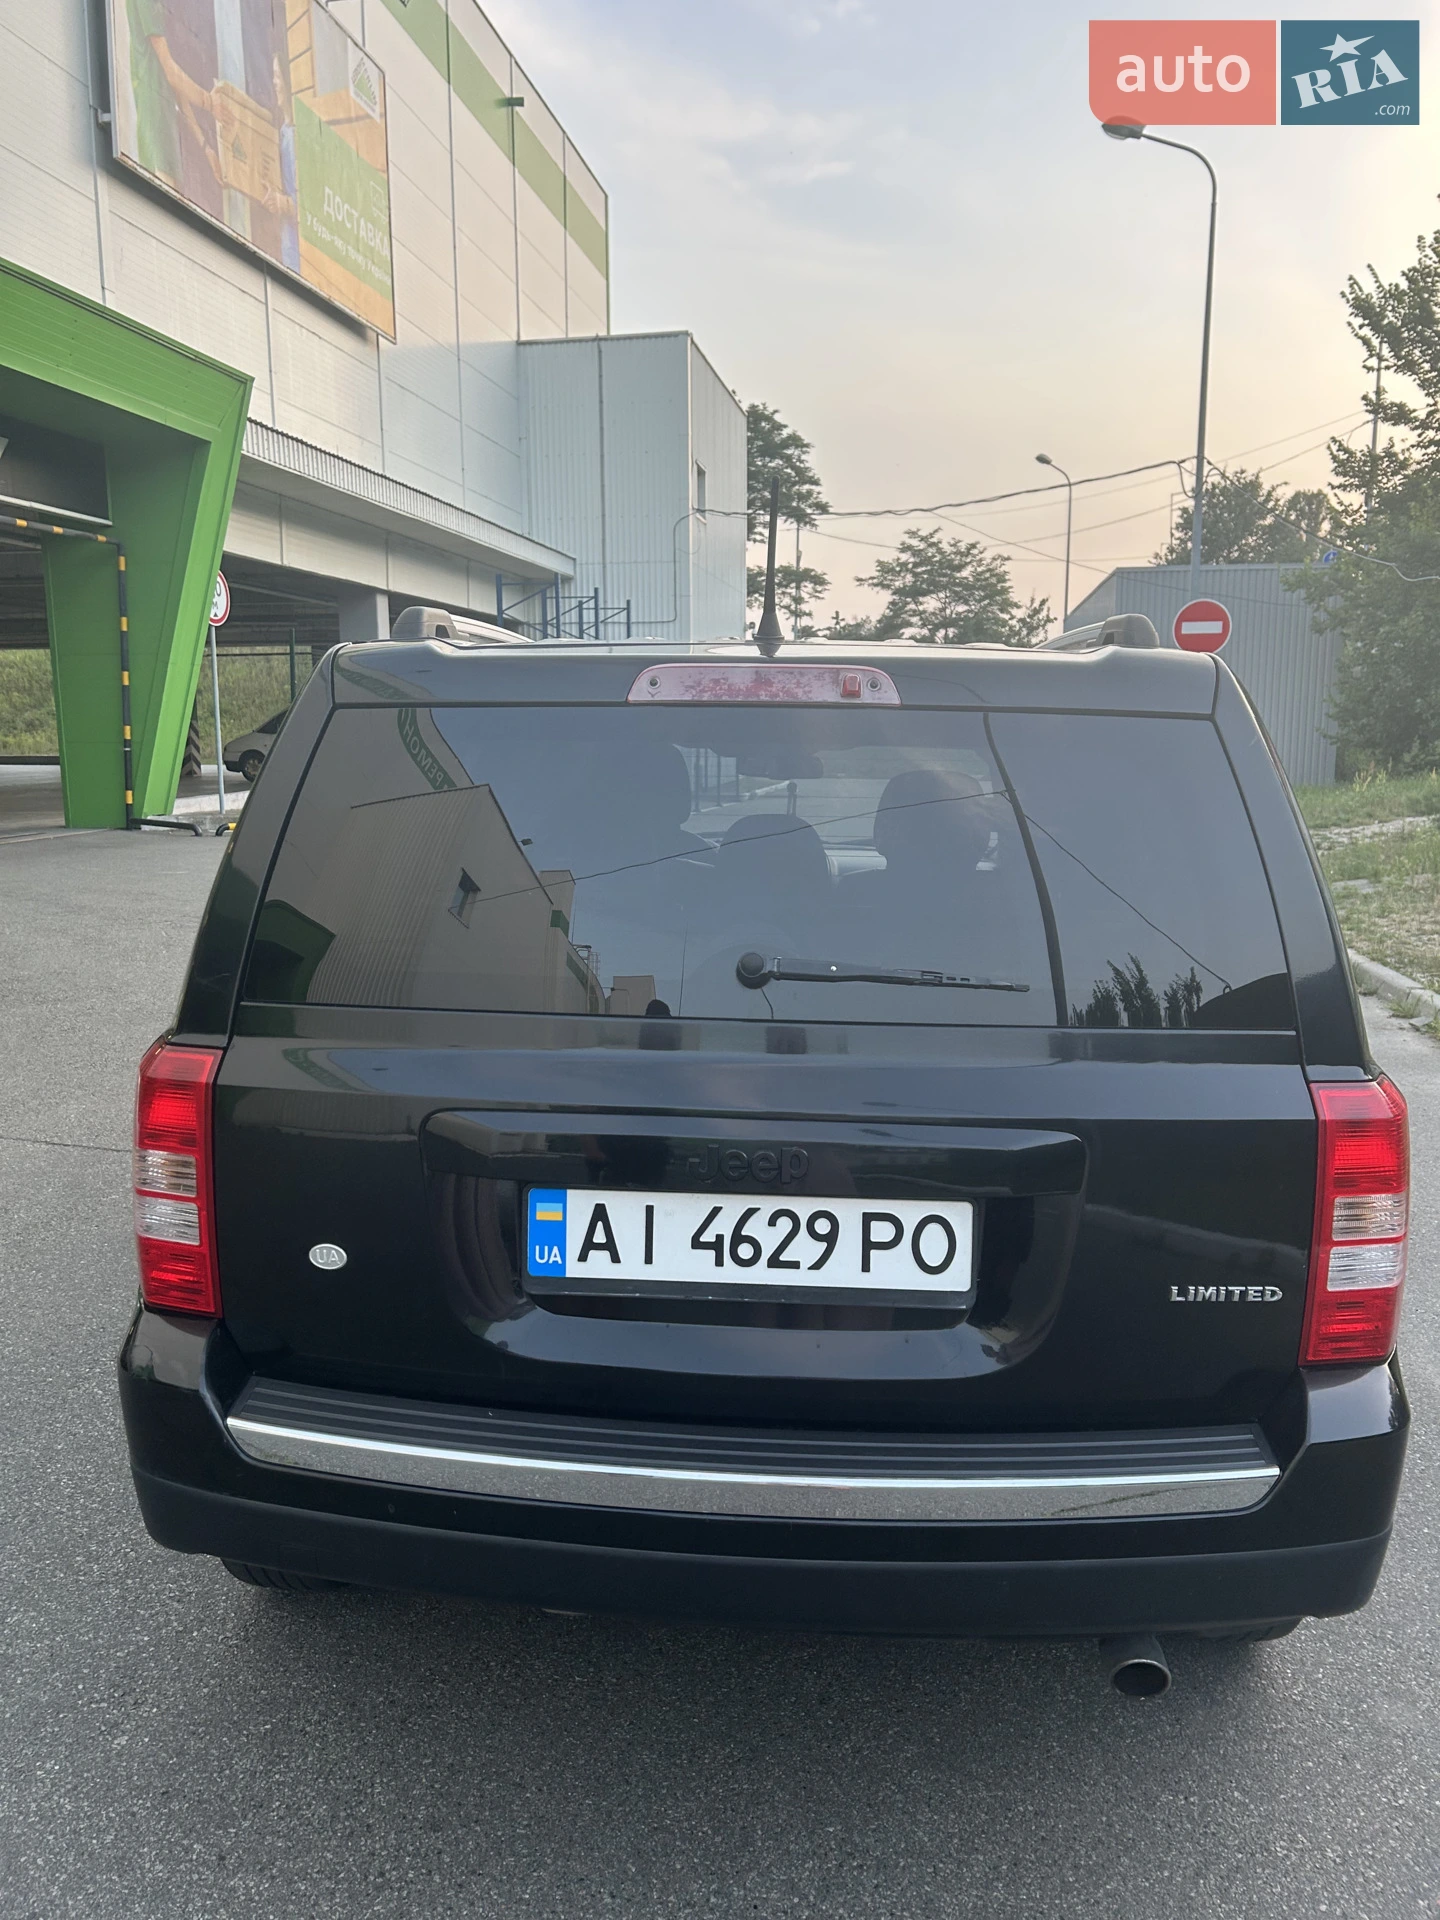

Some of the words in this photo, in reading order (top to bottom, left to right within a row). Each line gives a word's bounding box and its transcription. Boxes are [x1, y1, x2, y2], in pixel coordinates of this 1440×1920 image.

[324, 186, 391, 262] ДОСТАВКА
[688, 1145, 810, 1184] Jeep
[577, 1203, 655, 1265] AI
[690, 1206, 840, 1270] 4629
[861, 1212, 957, 1275] PO
[316, 1250, 341, 1264] UA
[535, 1245, 562, 1264] UA
[1170, 1286, 1283, 1301] LIMITED
